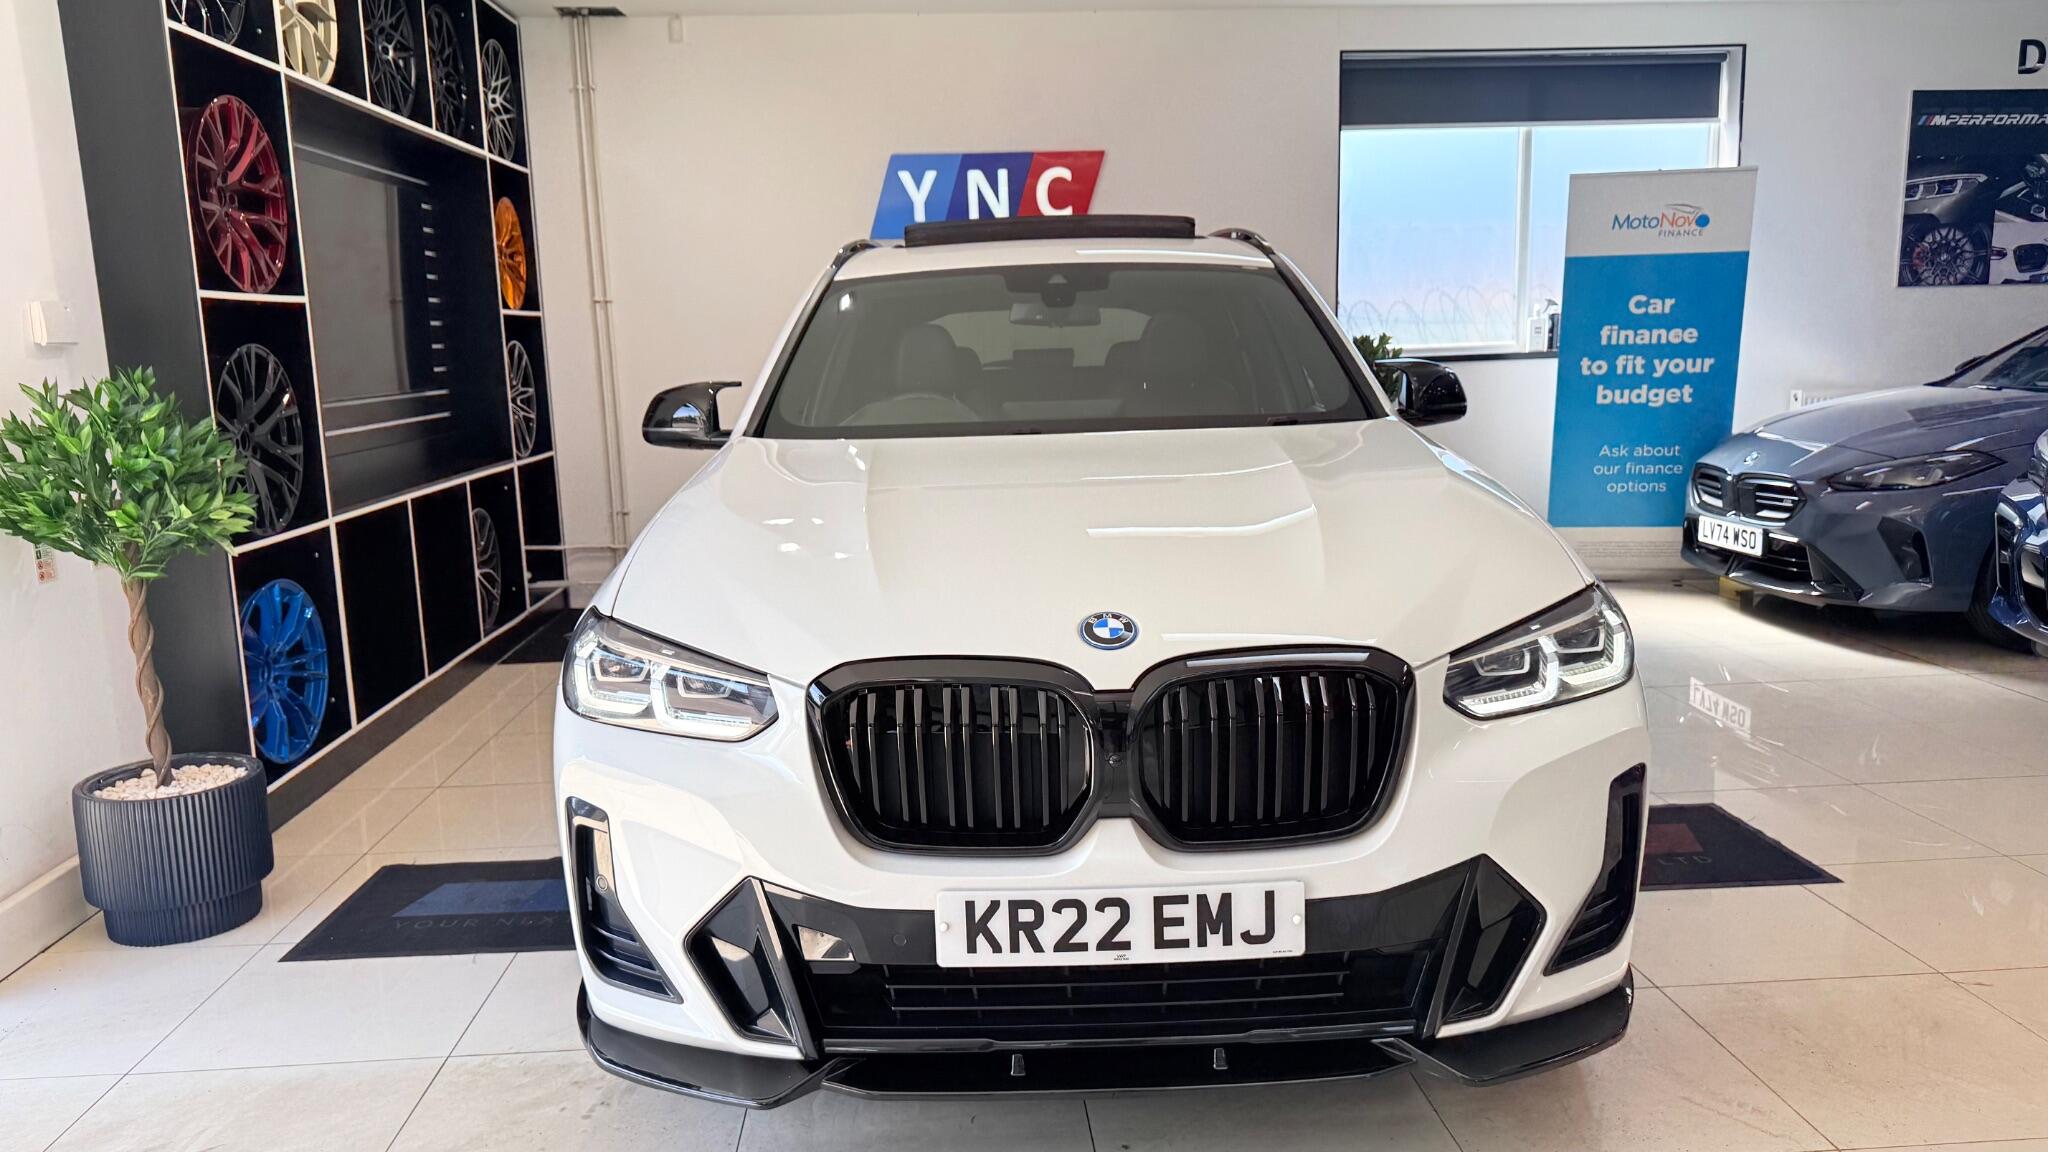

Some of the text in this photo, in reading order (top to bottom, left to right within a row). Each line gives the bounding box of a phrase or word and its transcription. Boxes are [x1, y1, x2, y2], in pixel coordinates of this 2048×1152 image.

[897, 166, 1073, 224] YNC
[1658, 229, 1703, 238] FINANCE
[1628, 294, 1676, 315] Car
[1600, 325, 1699, 346] finance
[1580, 355, 1715, 378] to fit your
[1596, 384, 1694, 408] budget
[1599, 444, 1681, 457] Ask about
[1593, 462, 1683, 475] our finance
[1606, 481, 1667, 494] options
[1733, 527, 1757, 550] WSO
[1088, 613, 1129, 624] BMW
[964, 890, 1276, 954] KR22 EMJ
